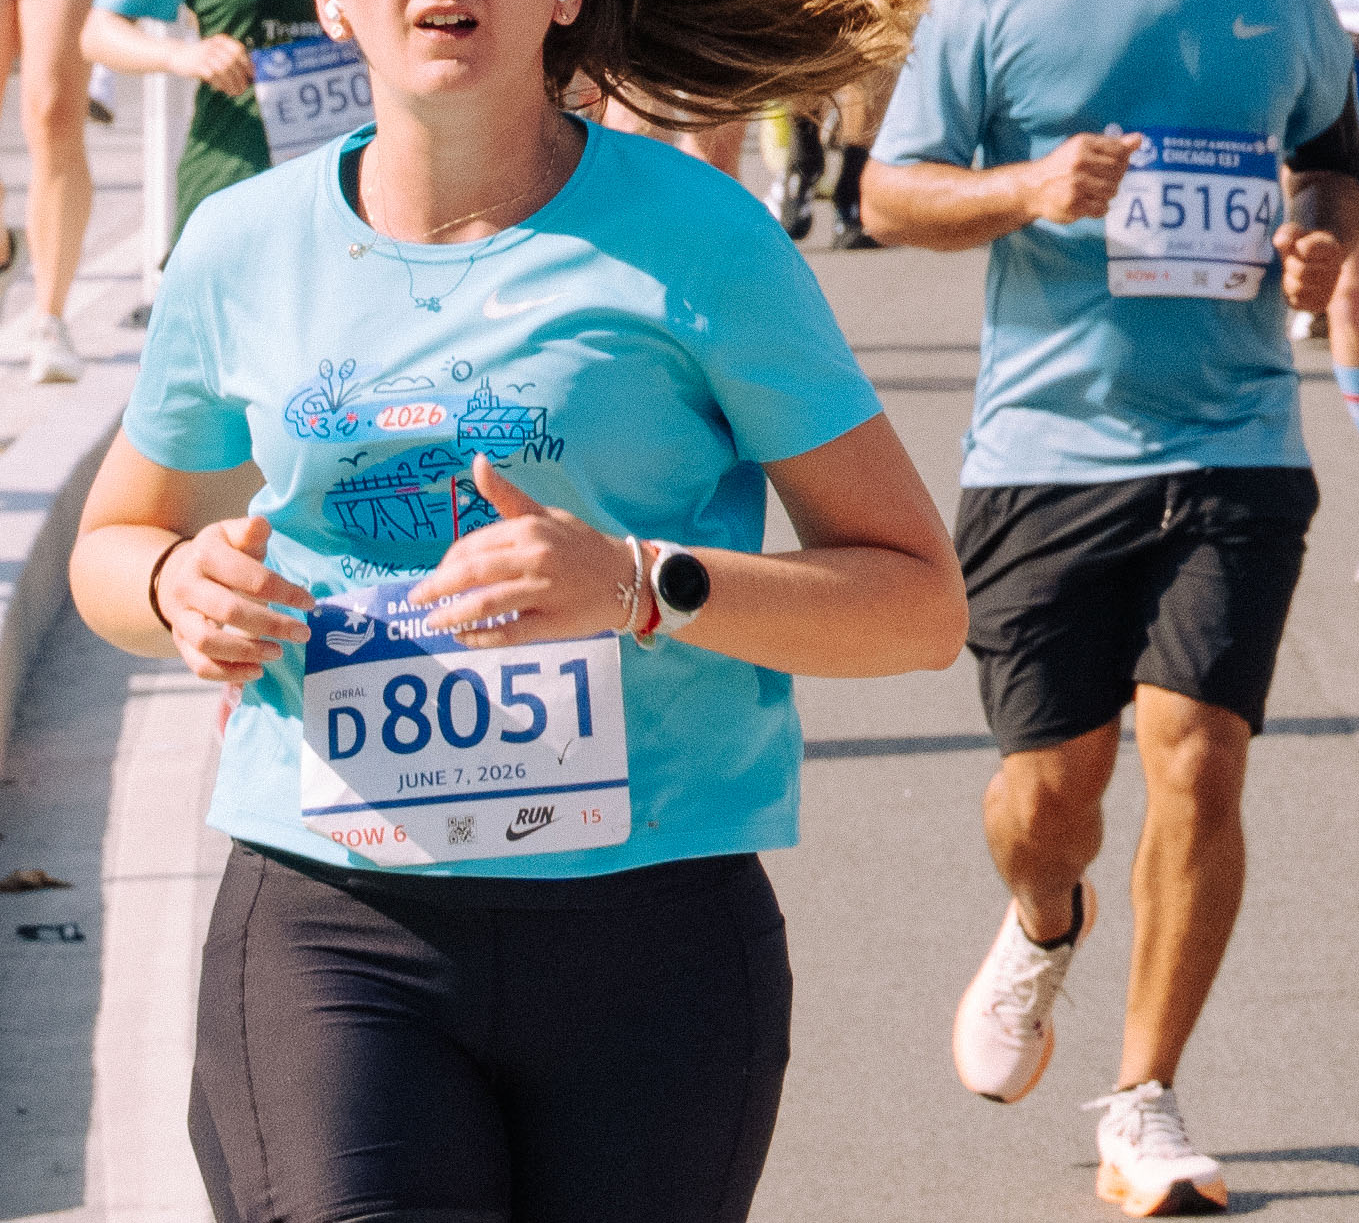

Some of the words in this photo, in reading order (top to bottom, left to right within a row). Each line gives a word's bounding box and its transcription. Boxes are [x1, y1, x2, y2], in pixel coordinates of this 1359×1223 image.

[1126, 198, 1150, 229] A
[1160, 182, 1271, 236] 5164
[381, 403, 443, 427] 2026
[341, 555, 402, 580] BANK
[328, 687, 367, 702] CORRAL
[328, 707, 366, 761] D
[381, 658, 594, 755] 8051
[397, 773, 448, 793] JUNE
[453, 769, 472, 788] 7,
[477, 763, 526, 782] 2026
[516, 806, 556, 826] RUN
[580, 809, 602, 825] 15
[393, 825, 407, 844] 6
